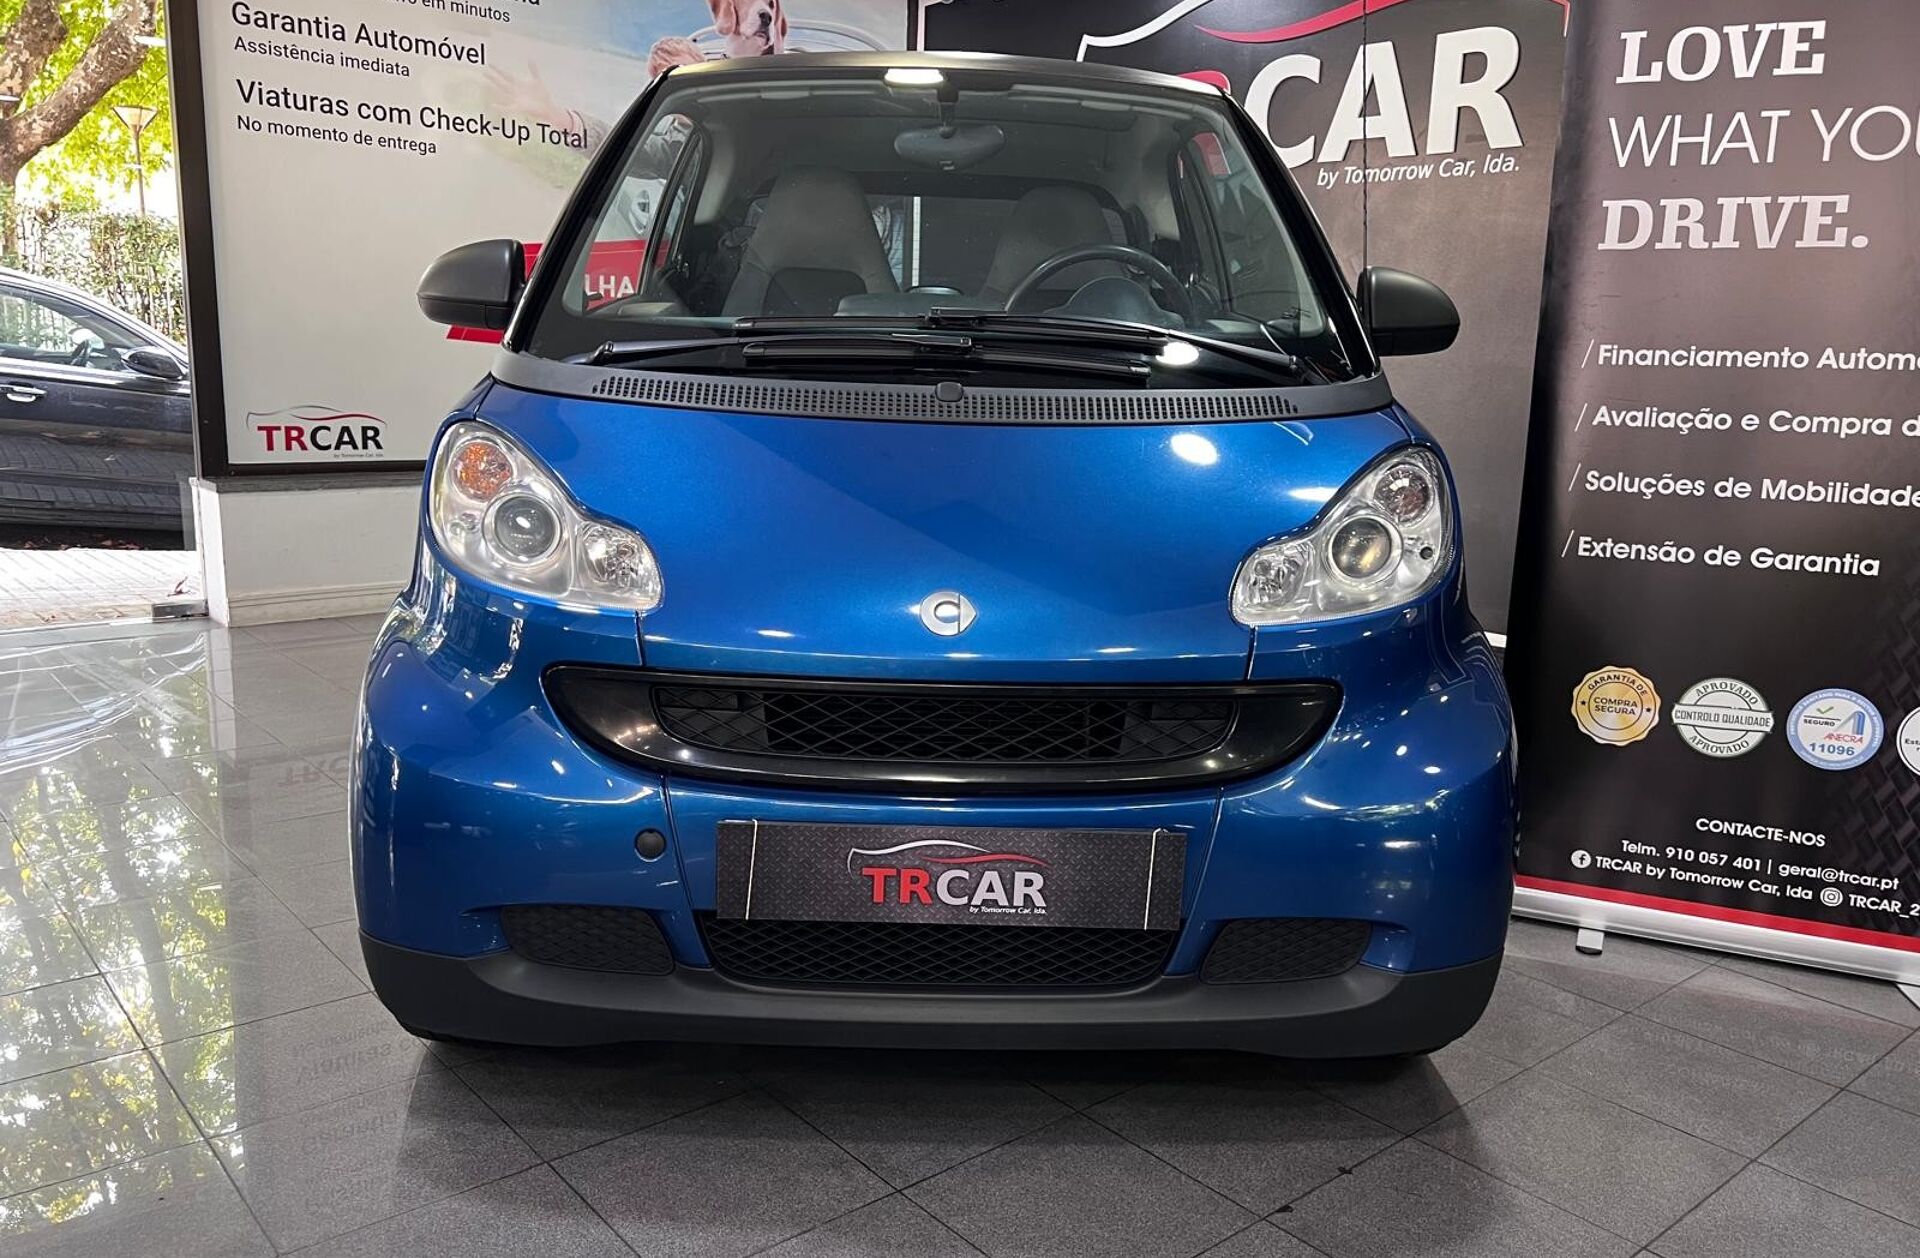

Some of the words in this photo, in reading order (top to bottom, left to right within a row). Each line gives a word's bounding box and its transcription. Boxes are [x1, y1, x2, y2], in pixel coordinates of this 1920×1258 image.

[450, 1, 511, 22] minutos
[232, 2, 346, 42] Garantia
[355, 23, 485, 65] Automóvel
[234, 36, 335, 65] Assistência
[340, 52, 410, 77] imediata
[1616, 20, 1826, 84] LOVE
[236, 78, 349, 117] Viaturas
[357, 102, 411, 125] com
[420, 106, 530, 146] Check-Up
[536, 122, 588, 149] Total
[237, 115, 262, 132] No
[267, 120, 348, 143] momento
[353, 130, 373, 146] de
[378, 135, 437, 155] entrega
[1609, 110, 1791, 168] WHAT
[1317, 167, 1338, 190] by
[1344, 163, 1432, 185] Tomorrow
[1439, 158, 1476, 178] Car,
[1598, 194, 1869, 250] DRIVE.
[584, 273, 635, 298] LHA
[1816, 347, 1920, 371] Autom
[1741, 413, 1760, 431] e
[1768, 409, 1892, 439] Compra
[257, 425, 384, 452] TRCAR
[1714, 477, 1752, 499] de
[1703, 545, 1742, 567] de
[1750, 547, 1880, 577] Garantia
[1588, 674, 1636, 691] GARANTIA
[1636, 683, 1649, 697] DE
[1694, 681, 1759, 706] APROVADO
[1593, 696, 1639, 708] COMPRA
[1594, 704, 1637, 716] SEGURA
[1674, 709, 1720, 723] CONTROLO
[1721, 713, 1771, 728] QUALIDADE
[1803, 718, 1836, 728] SEGURO
[1688, 735, 1750, 754] APROVADO
[1809, 742, 1856, 756] 11096
[1823, 731, 1864, 745] ANECRA
[1695, 817, 1826, 847] CONTACTE-NOS
[1595, 855, 1643, 875] TRCAR
[1645, 863, 1666, 880] by
[1669, 867, 1744, 889] Tomorrow
[1748, 879, 1781, 898] Car,
[1621, 839, 1661, 857] Telm.
[1665, 845, 1695, 862] 910
[1698, 850, 1729, 867] 057
[1732, 856, 1762, 872] 401
[1778, 863, 1900, 891] geral@trcar.pt
[861, 867, 1047, 907] TRCAR
